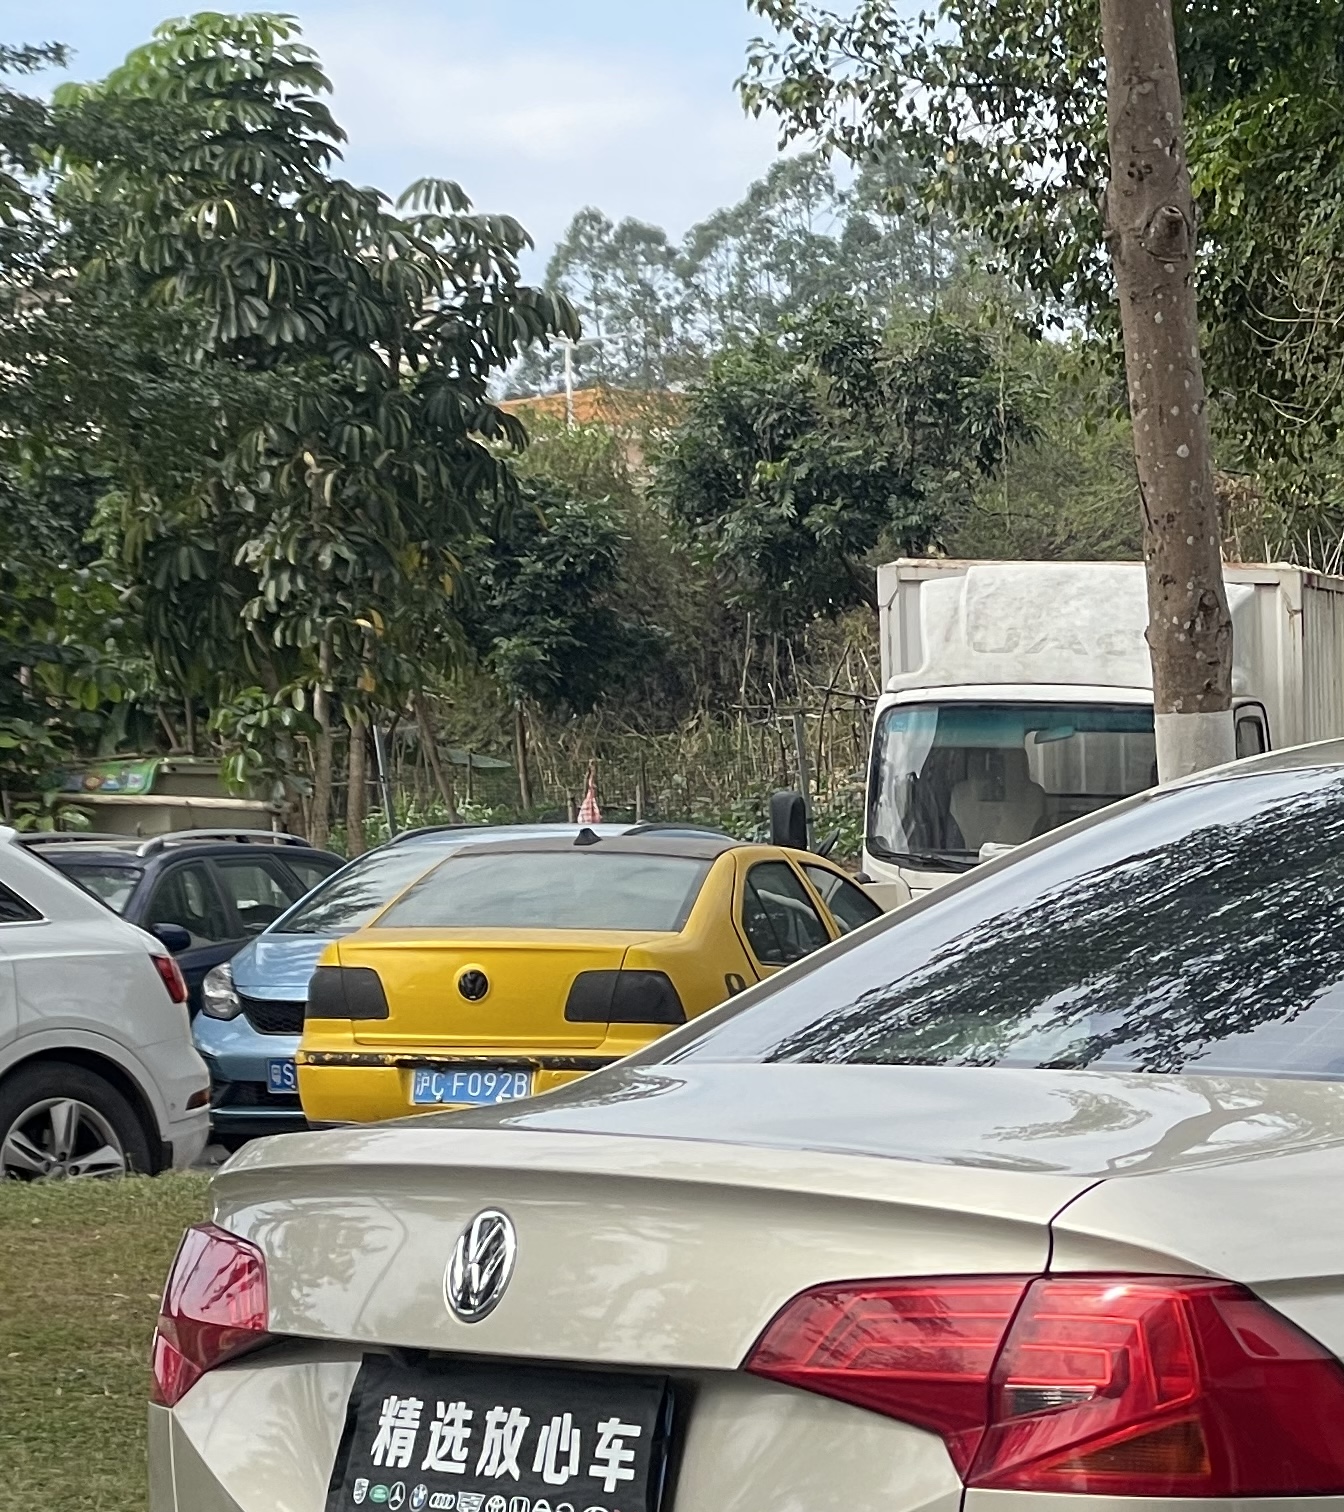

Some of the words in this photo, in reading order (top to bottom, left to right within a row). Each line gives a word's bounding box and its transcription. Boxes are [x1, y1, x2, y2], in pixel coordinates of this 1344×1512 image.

[371, 1395, 642, 1493] 精选放心车
